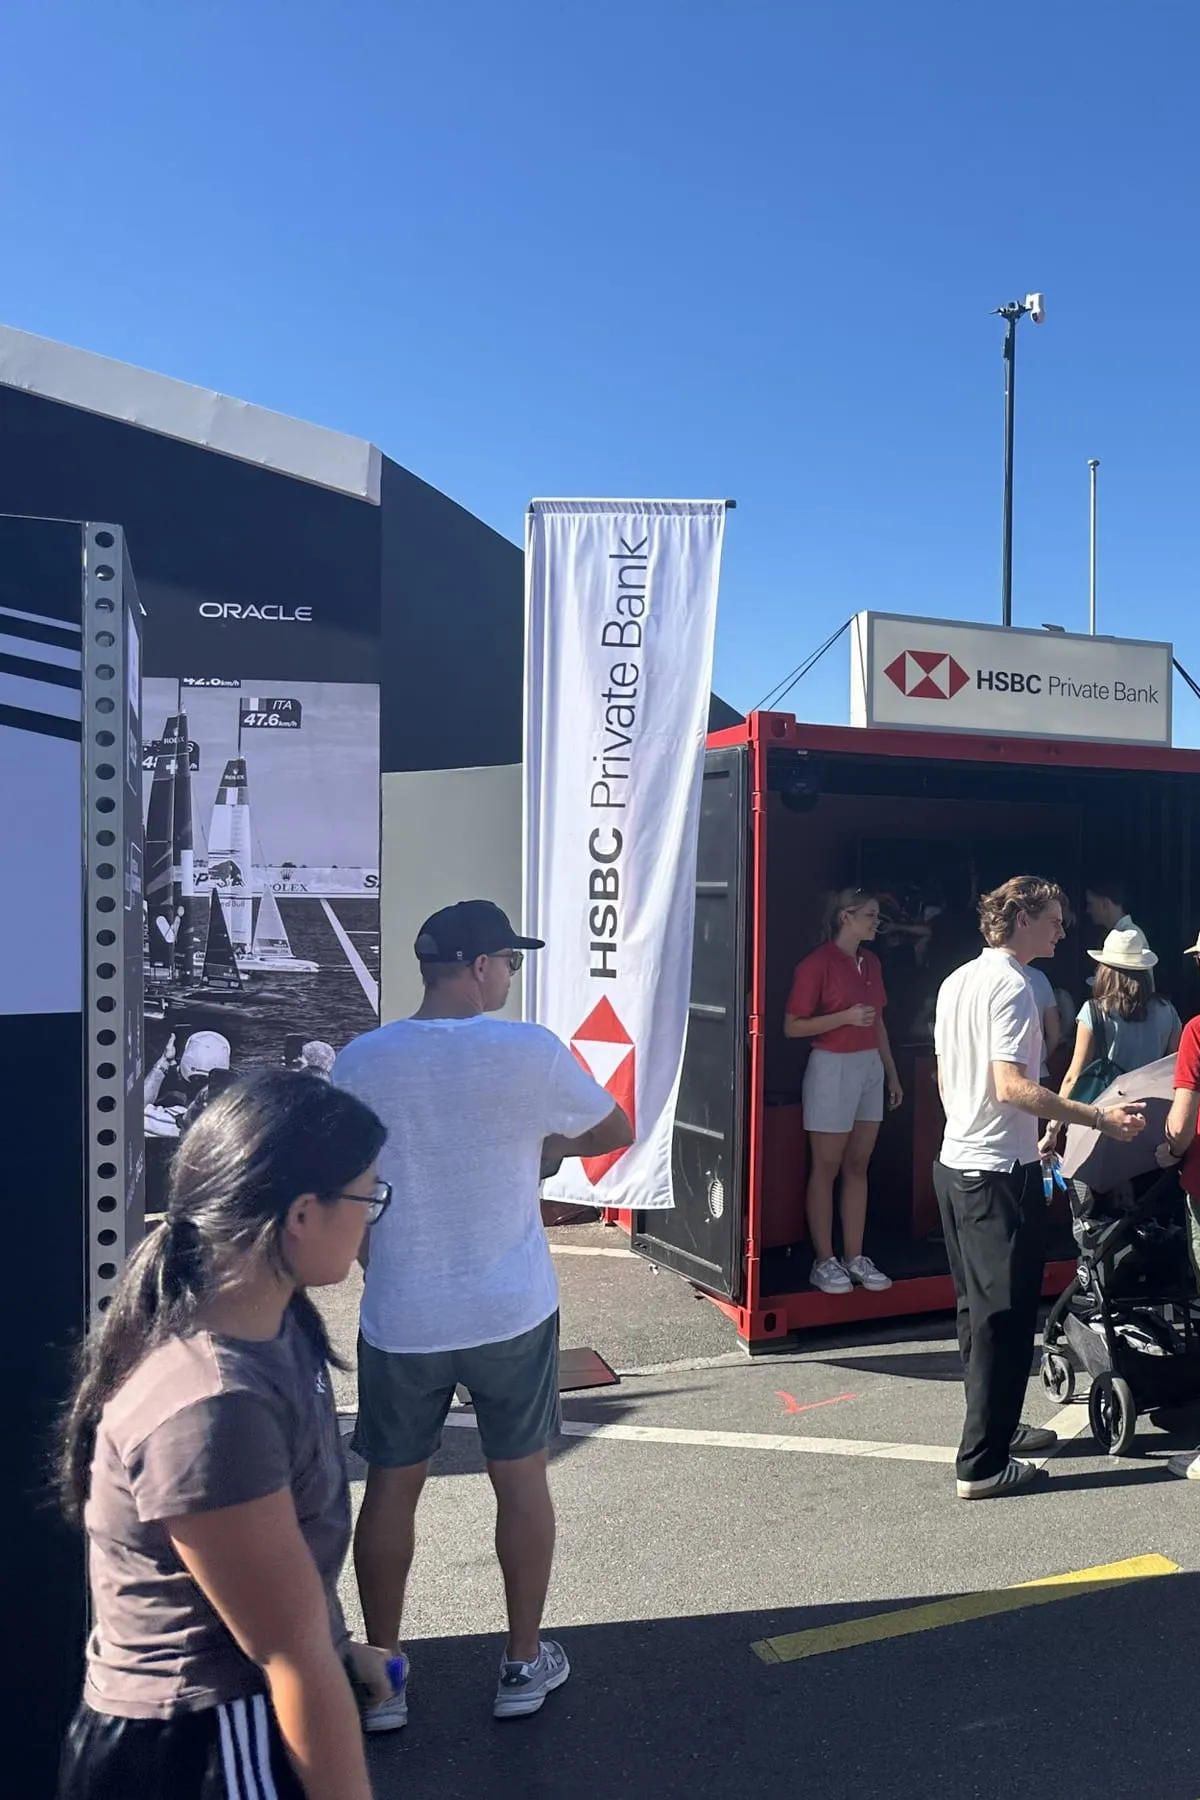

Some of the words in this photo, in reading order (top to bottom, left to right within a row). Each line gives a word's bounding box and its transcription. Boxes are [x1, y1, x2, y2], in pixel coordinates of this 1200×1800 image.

[199, 602, 313, 622] ORACLE
[600, 535, 649, 649] Bank
[272, 700, 293, 711] ITA
[976, 669, 1042, 695] HSBC
[1048, 676, 1110, 700] Private
[1114, 682, 1159, 704] Bank
[590, 662, 640, 809] Private
[588, 828, 624, 979] HSBC
